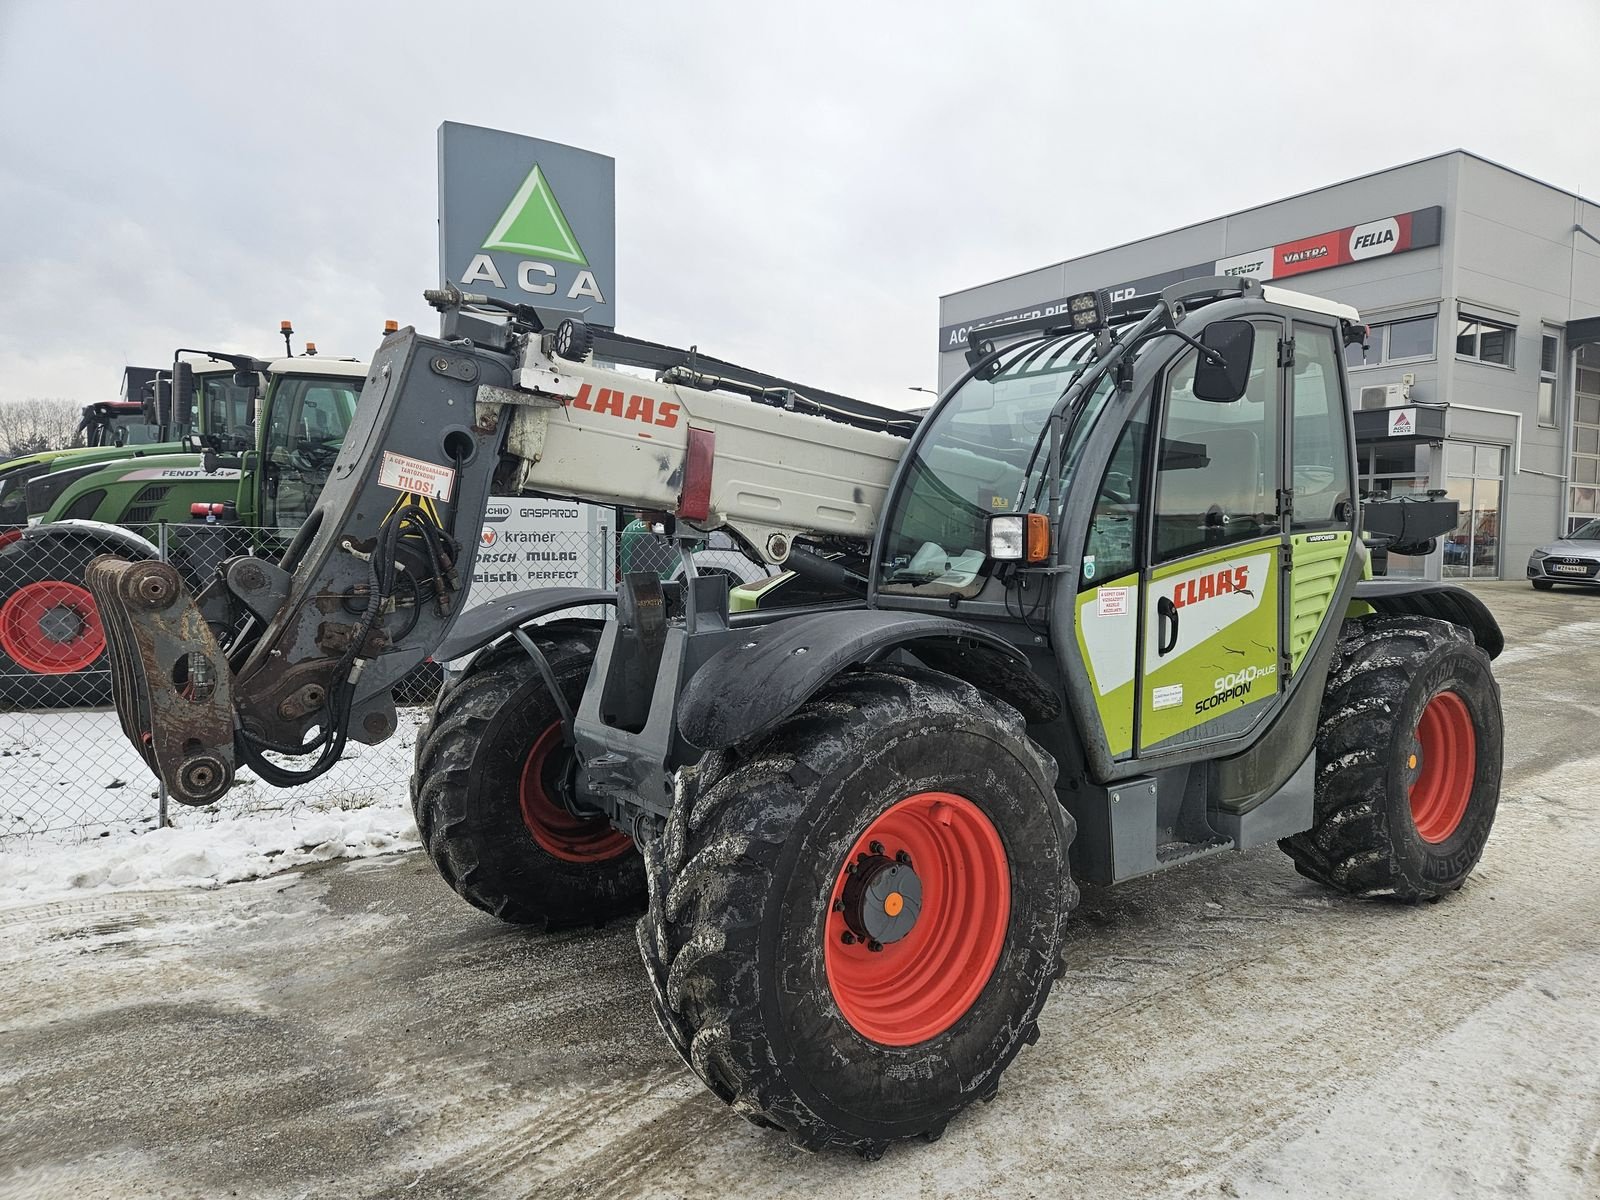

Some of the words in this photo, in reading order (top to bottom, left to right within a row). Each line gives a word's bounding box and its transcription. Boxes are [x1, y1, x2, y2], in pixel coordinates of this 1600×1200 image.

[1353, 229, 1394, 250] FELLA
[1283, 246, 1328, 264] VALTRA
[460, 253, 606, 304] ACA
[1224, 261, 1264, 276] FENDT
[557, 383, 681, 428] LAAS
[398, 474, 434, 494] TILOS!
[519, 508, 579, 519] GASPARDO
[505, 531, 556, 543] kramer
[528, 571, 579, 579] PERFECT
[1173, 565, 1249, 609] CLAAS
[1214, 666, 1257, 695] 9040
[1257, 664, 1276, 678] PLUS
[1195, 681, 1251, 714] SCORPION
